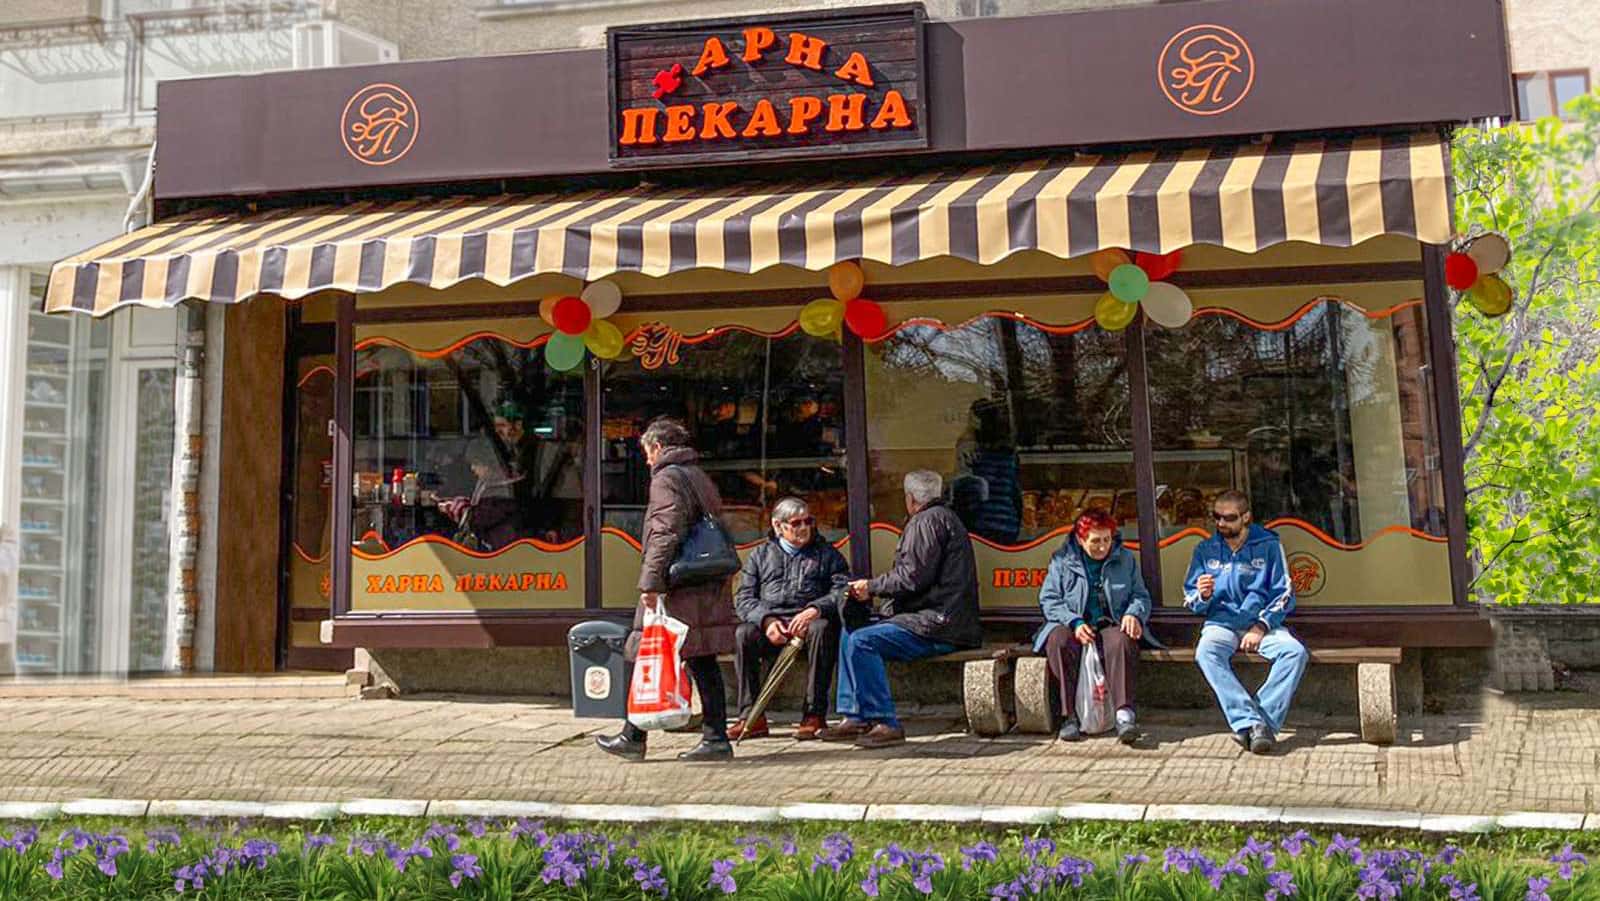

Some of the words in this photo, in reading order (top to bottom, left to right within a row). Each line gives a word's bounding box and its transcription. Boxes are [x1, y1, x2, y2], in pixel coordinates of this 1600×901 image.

[619, 90, 912, 145] ПЕКАРНА
[366, 574, 445, 593] ХАРНА
[454, 572, 569, 592] ПЕКАРНА
